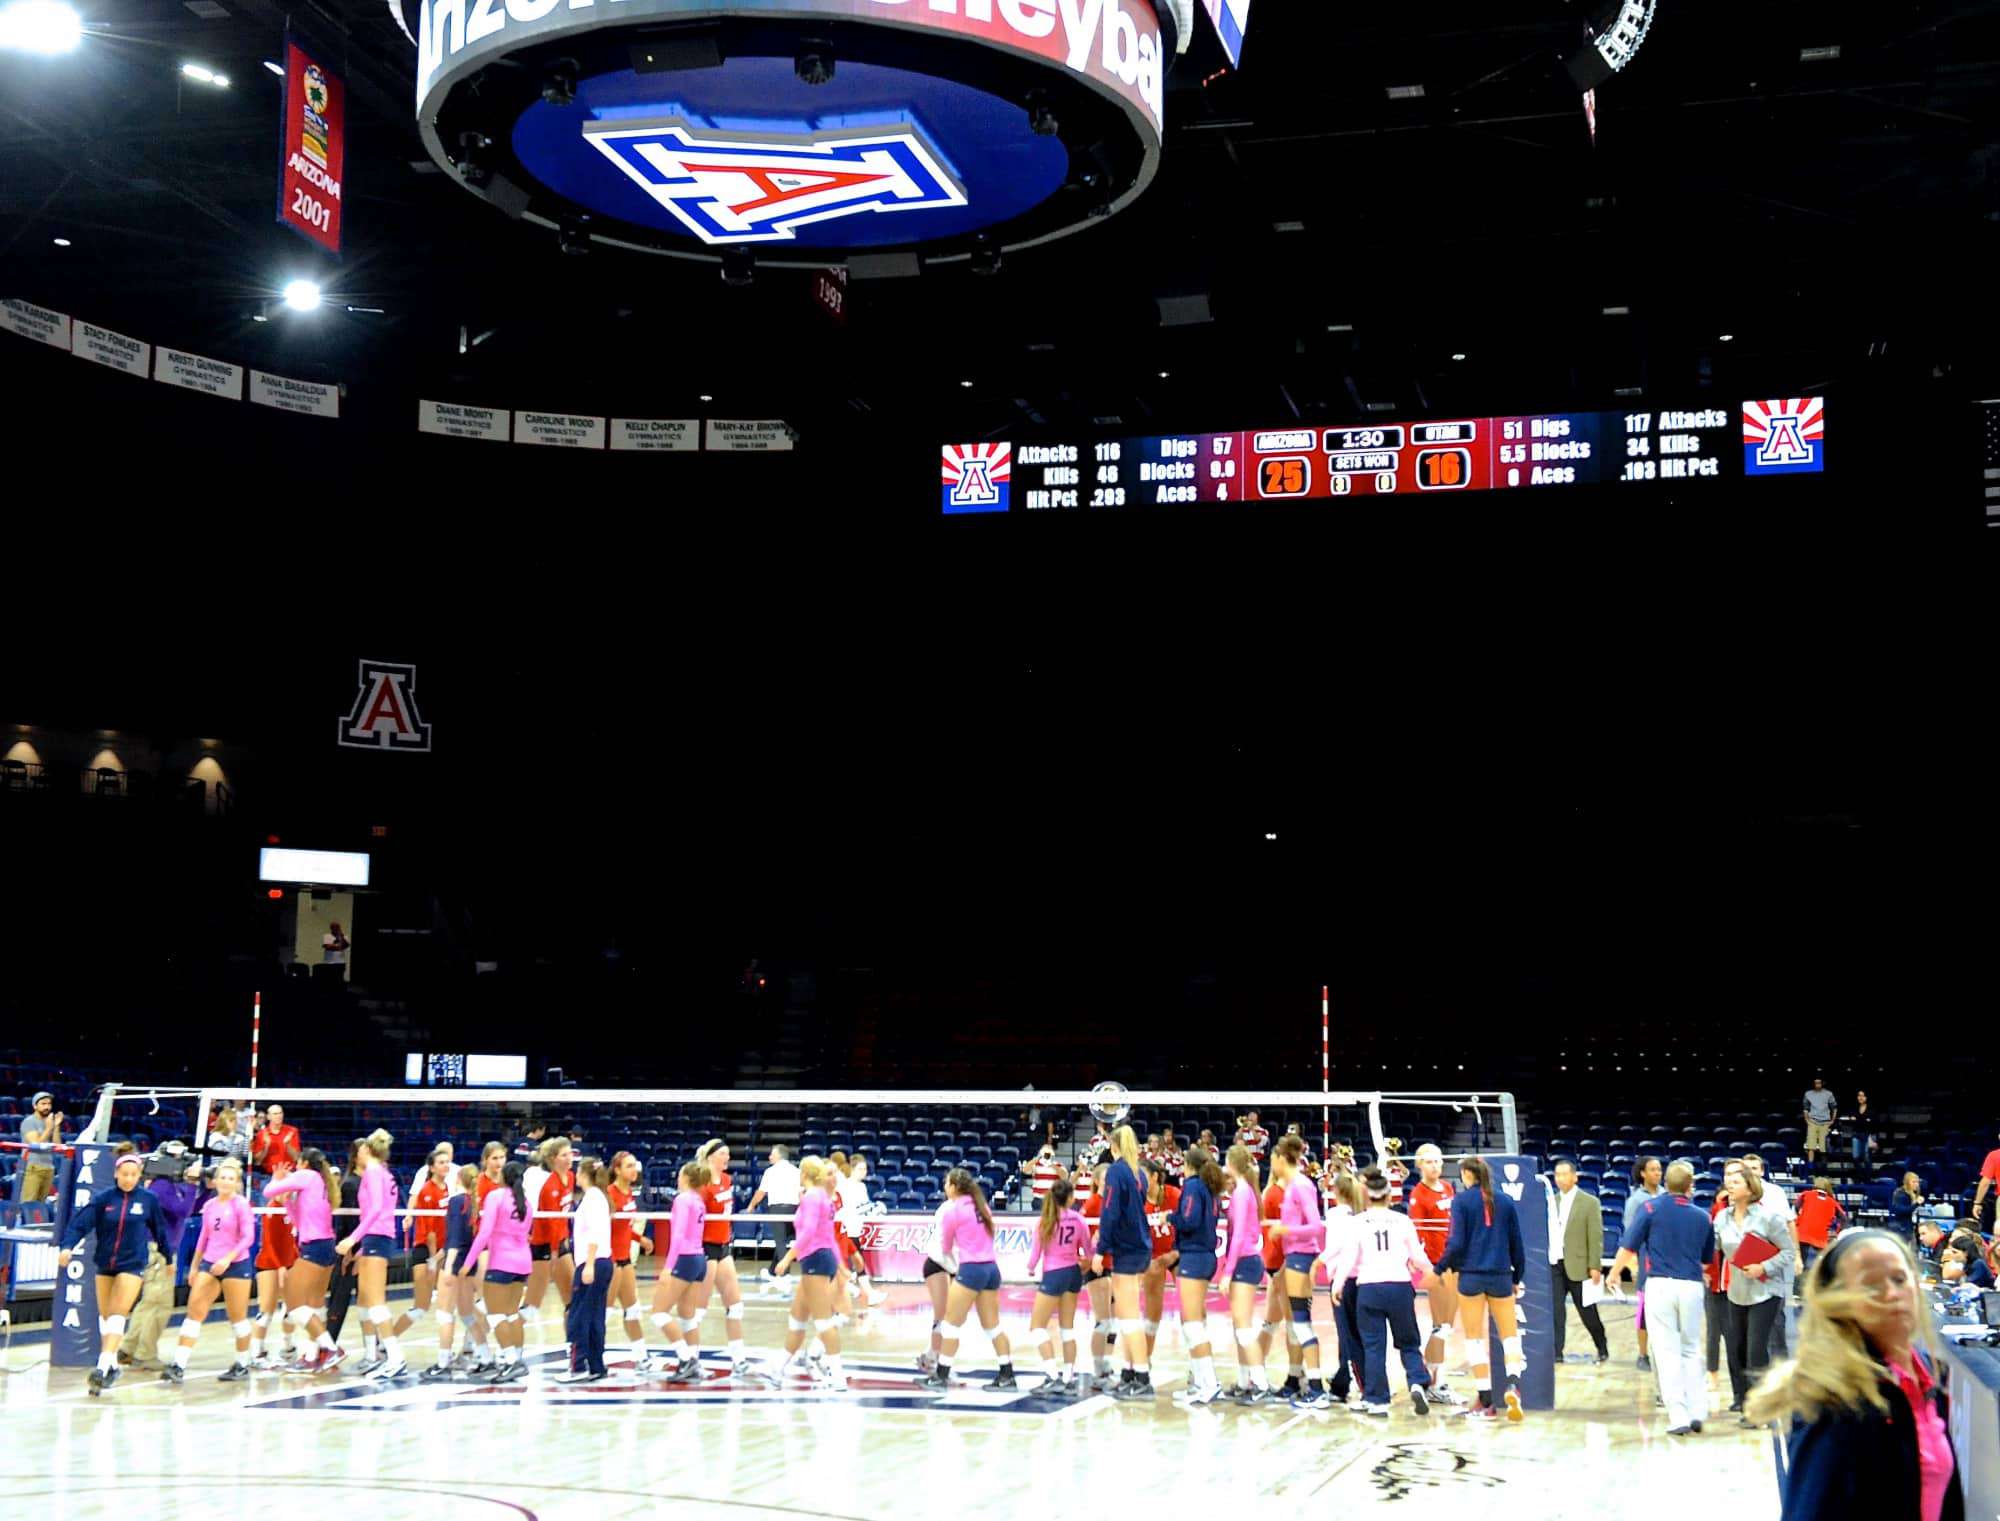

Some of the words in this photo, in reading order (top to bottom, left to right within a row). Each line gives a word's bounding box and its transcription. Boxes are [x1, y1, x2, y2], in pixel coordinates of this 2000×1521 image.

[288, 153, 340, 200] ARIZONA
[292, 187, 330, 232] 2001
[84, 325, 106, 341] STACY
[88, 340, 135, 362] GYMNASTICS
[168, 353, 194, 366] KRISTI
[173, 366, 226, 385] GYMNASTICS
[260, 375, 282, 389] ANNA
[267, 389, 320, 405] GYMNASTICS
[436, 404, 460, 417] DIANE
[463, 407, 493, 420] MONTY
[525, 414, 565, 426] CAROLINE
[568, 416, 594, 428] WOOD
[1624, 413, 1651, 432] 117
[1659, 410, 1727, 430] Attacks
[436, 416, 492, 430] GYMNASTICS
[531, 426, 587, 437] GYMNASTICS
[625, 422, 648, 431] KELLY
[651, 421, 686, 431] CHAPLIN
[714, 421, 754, 432] MARY-KAY
[1503, 421, 1523, 440] 51
[1531, 419, 1570, 438] Digs
[627, 432, 682, 441] GYMNASTICS
[723, 432, 776, 441] GYMNASTICS
[1343, 431, 1385, 448] 1:30
[1627, 438, 1650, 456] 34
[1659, 435, 1699, 454] Kills
[1018, 445, 1078, 464] Attacks
[1161, 438, 1198, 458] Digs
[1213, 437, 1233, 455] 57
[1500, 445, 1526, 463] 5.5
[1531, 441, 1590, 461] Blocks
[1140, 462, 1195, 481] Blocks
[1210, 460, 1235, 478] 9.0
[1335, 455, 1361, 470] SETS
[1364, 453, 1388, 468] WON
[1425, 452, 1460, 486] 16
[1660, 459, 1688, 478] Hit
[1689, 458, 1719, 477] Pct
[1044, 466, 1079, 486] Kills
[1266, 461, 1302, 493] 25
[1508, 469, 1520, 486] 0
[1531, 467, 1574, 484] Aces
[1026, 490, 1052, 509] Hit
[1053, 489, 1079, 508] Pct
[1156, 485, 1197, 503] Aces
[1216, 483, 1228, 501] 4
[214, 1217, 221, 1231] 2
[1154, 1224, 1170, 1238] 14
[1058, 1225, 1075, 1246] 12
[1374, 1229, 1389, 1251] 11
